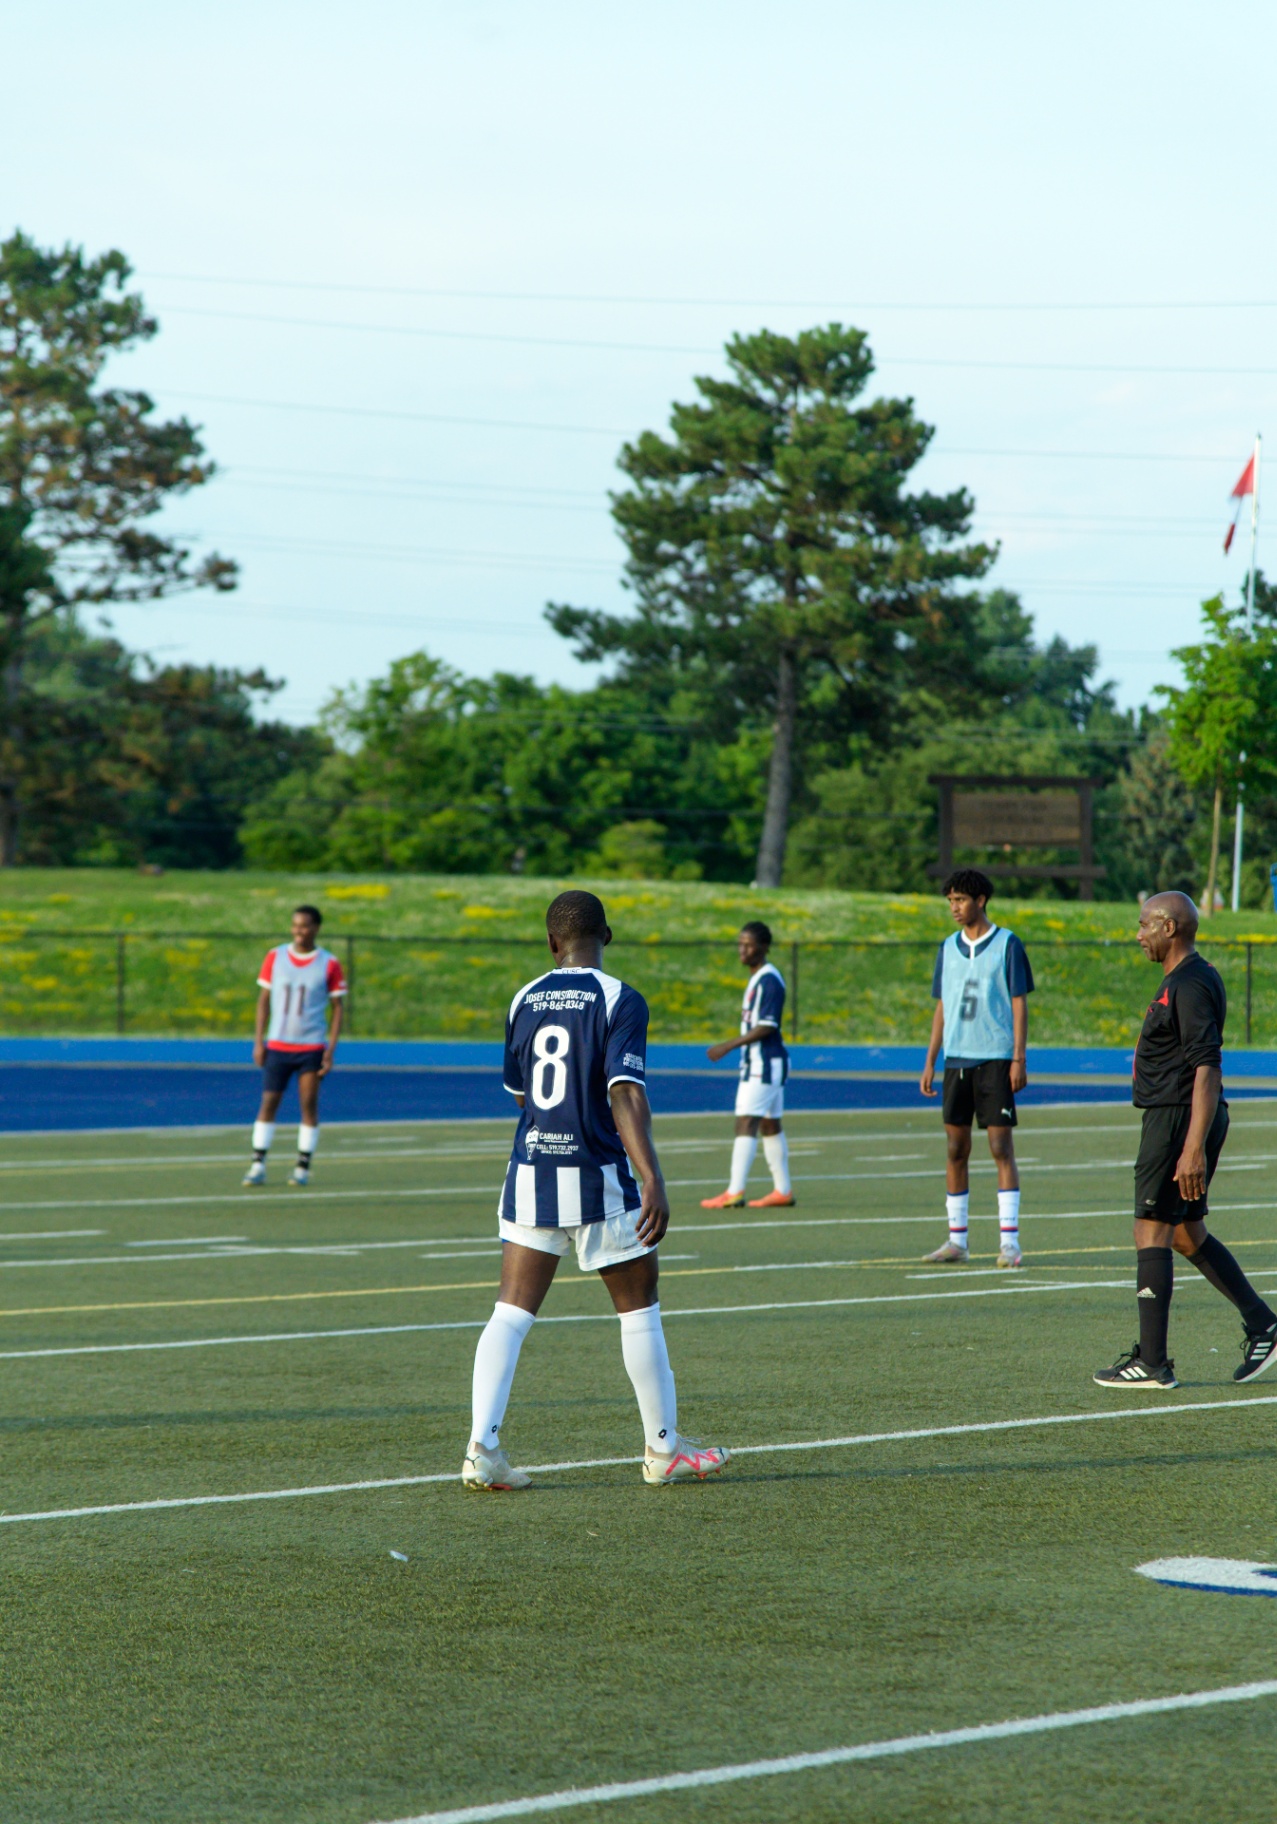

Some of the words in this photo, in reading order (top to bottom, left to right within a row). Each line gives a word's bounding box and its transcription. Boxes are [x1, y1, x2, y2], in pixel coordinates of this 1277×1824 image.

[283, 984, 306, 1017] 11
[524, 991, 545, 1004] JOSEF
[532, 1024, 570, 1110] 8
[539, 1132, 562, 1141] CARIAH
[562, 1133, 574, 1141] ALI
